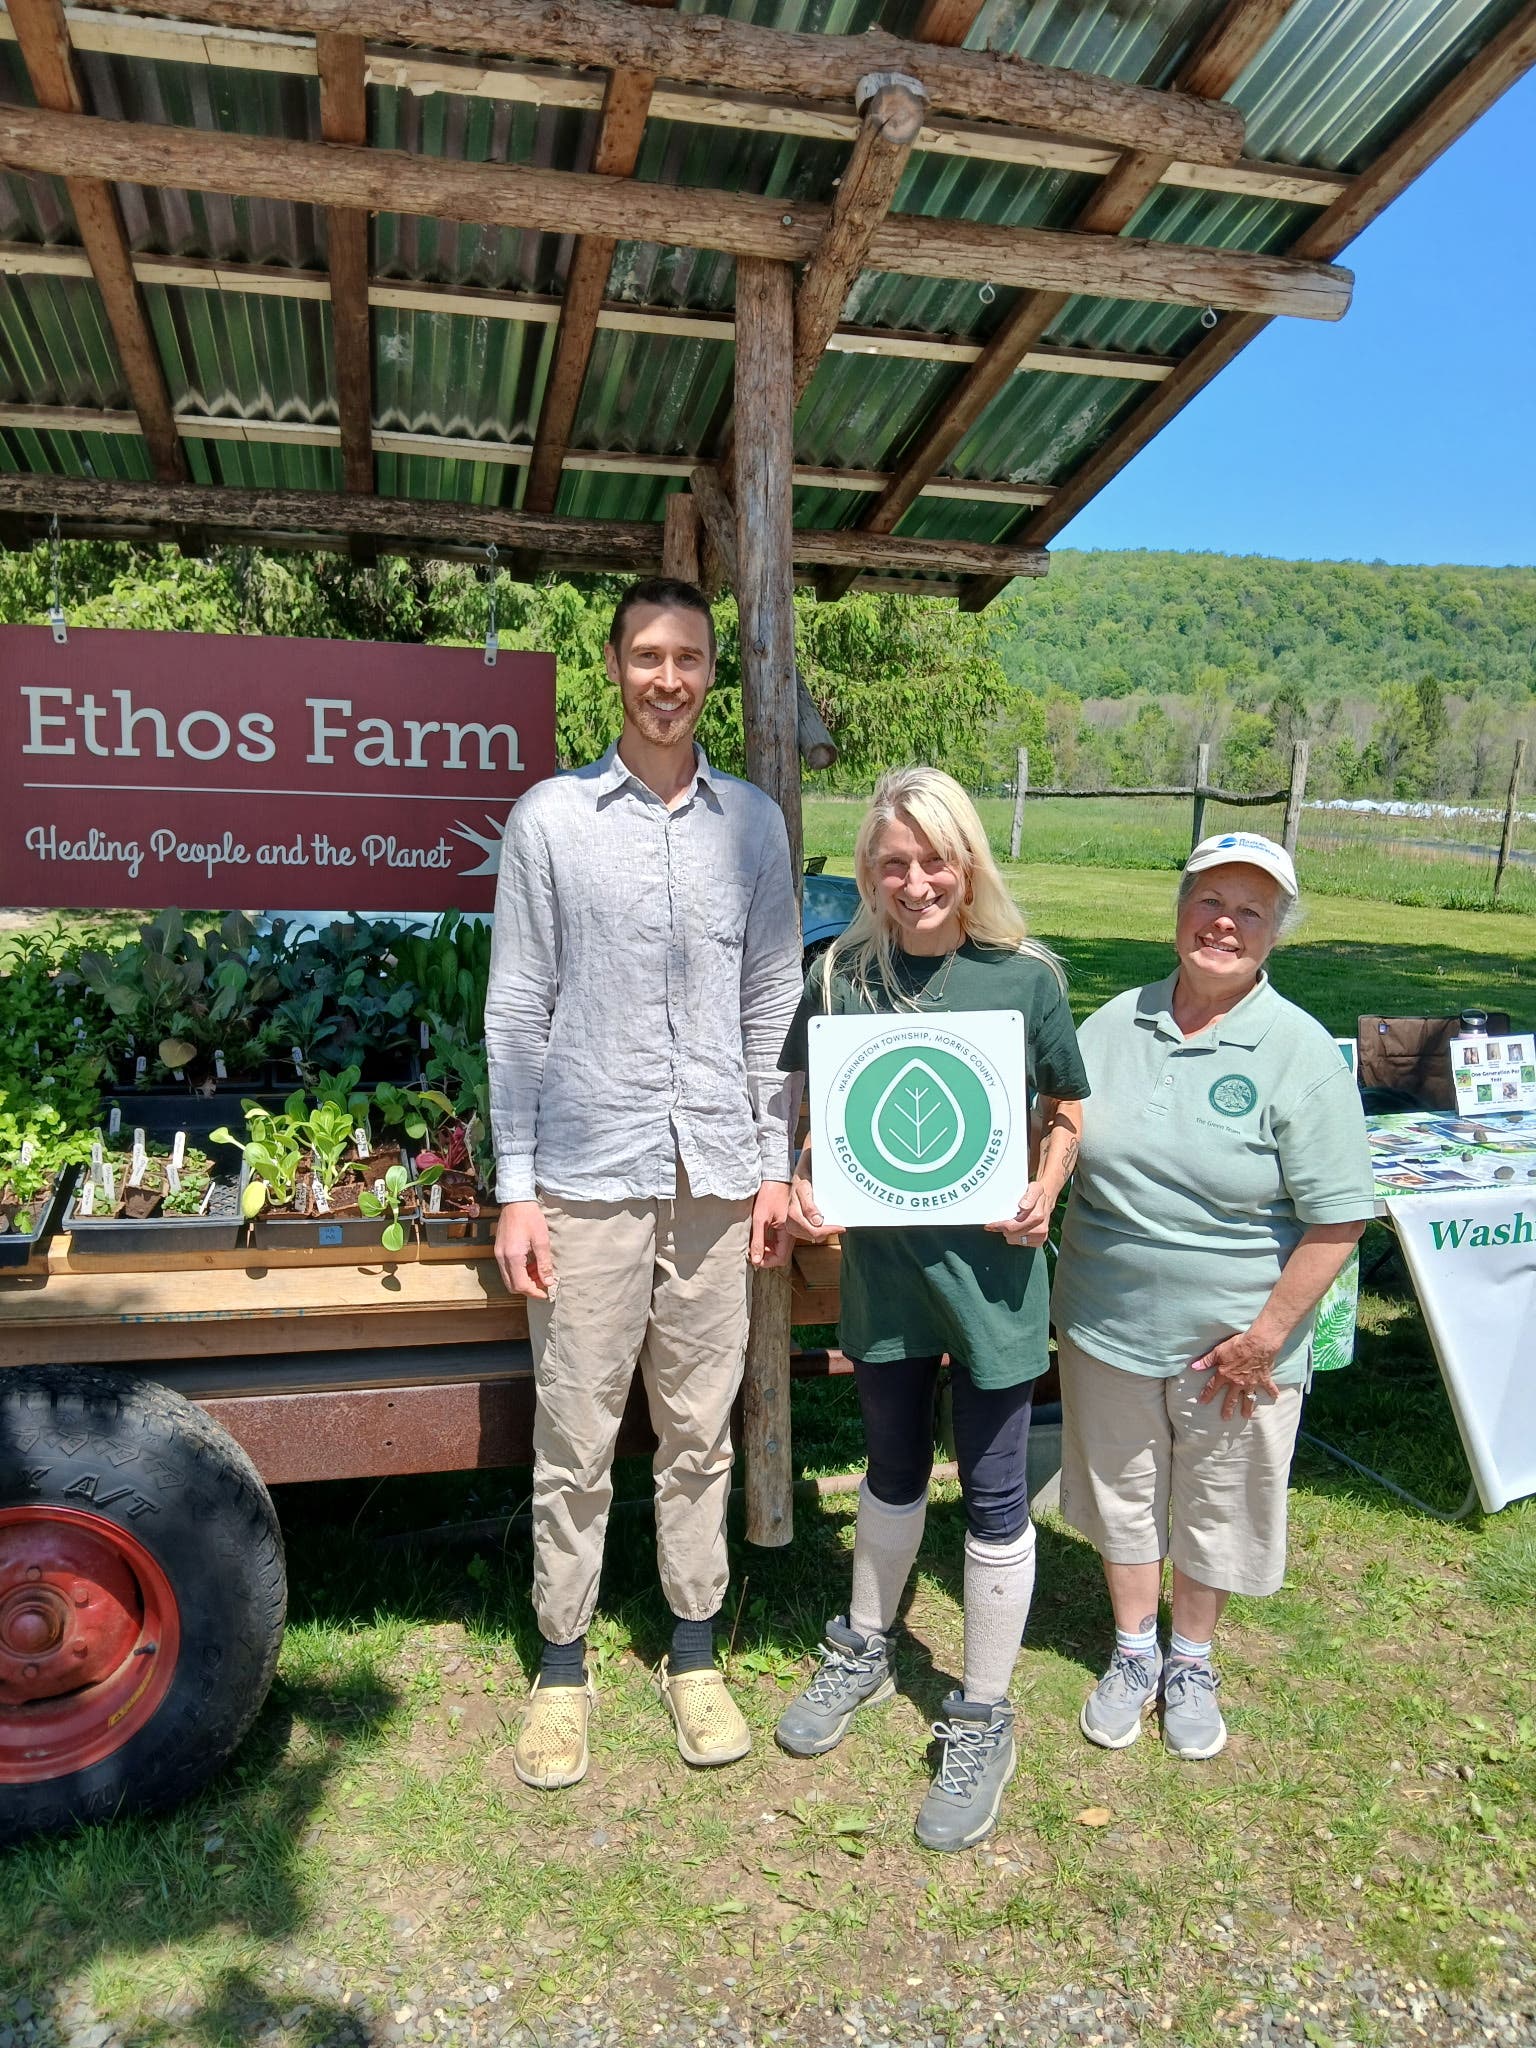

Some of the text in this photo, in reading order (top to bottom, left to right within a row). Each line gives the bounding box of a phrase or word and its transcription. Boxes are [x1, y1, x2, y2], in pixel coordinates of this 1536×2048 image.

[21, 686, 525, 771] Ethos Farm
[25, 825, 454, 878] Healing People and the Planet
[838, 1032, 996, 1092] WASHINGTON TOWNSHIP, MORRIS COUNTY
[835, 1128, 1004, 1208] RECOGNIZED GREEN BUSINESS
[1429, 1211, 1536, 1250] Wash
[61, 1472, 162, 1520] A/T
